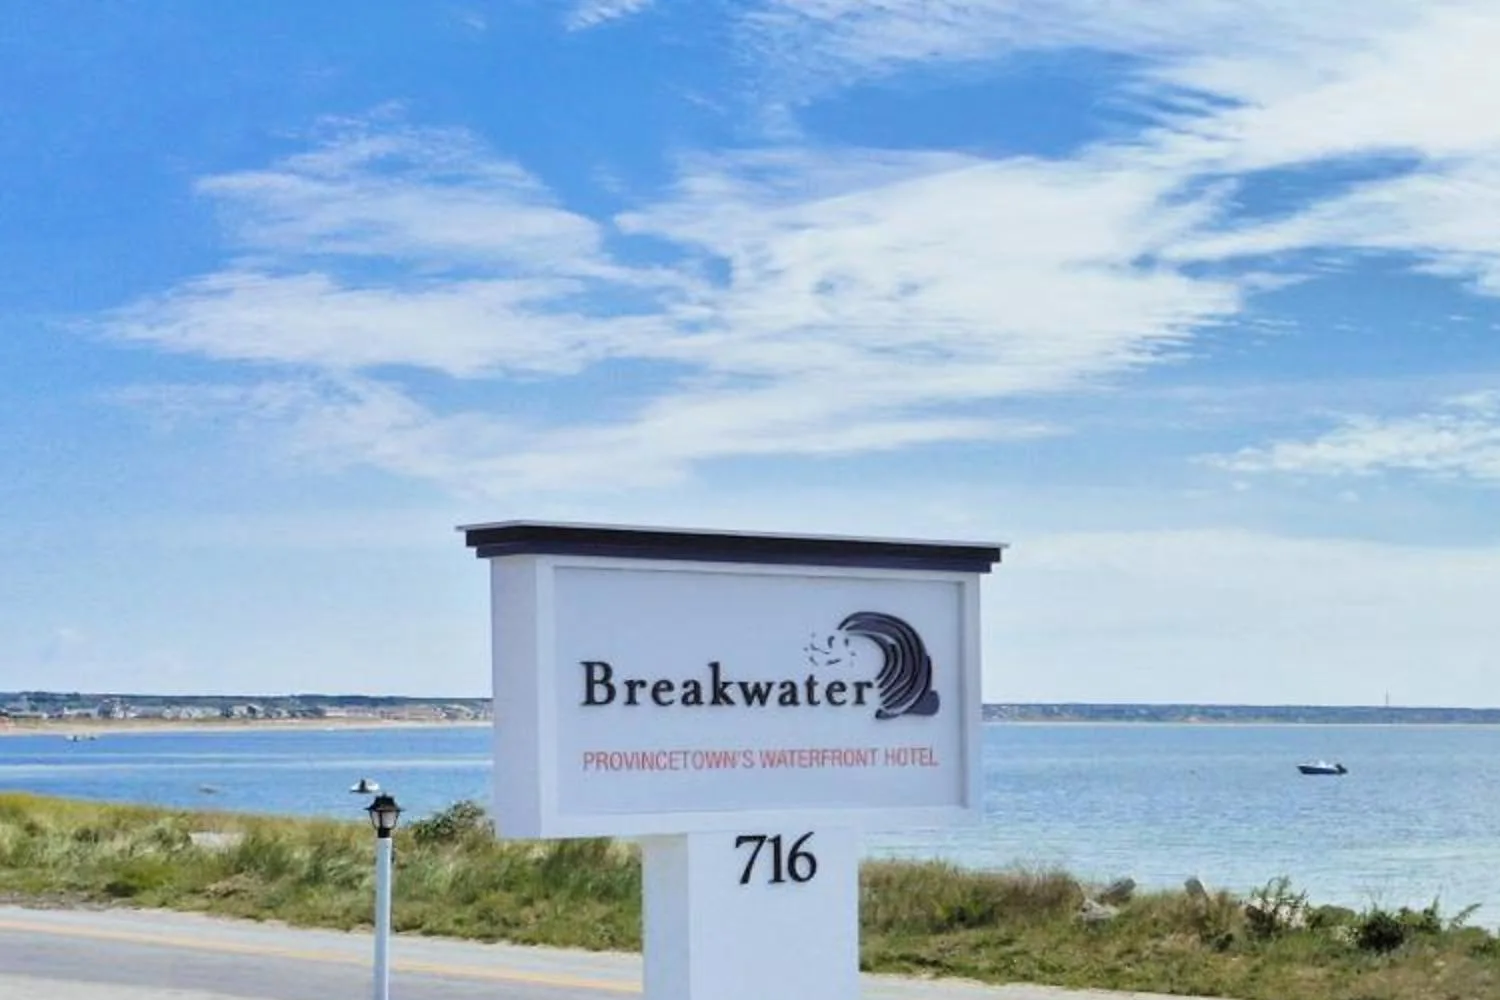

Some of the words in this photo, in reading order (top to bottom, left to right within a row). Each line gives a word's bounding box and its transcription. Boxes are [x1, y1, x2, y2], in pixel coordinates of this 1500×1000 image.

[579, 660, 873, 708] Breakwater
[583, 750, 755, 772] PROVINCETOWN'S
[759, 749, 877, 769] WATERFRONT
[884, 746, 940, 768] HOTEL
[734, 831, 818, 885] 716
